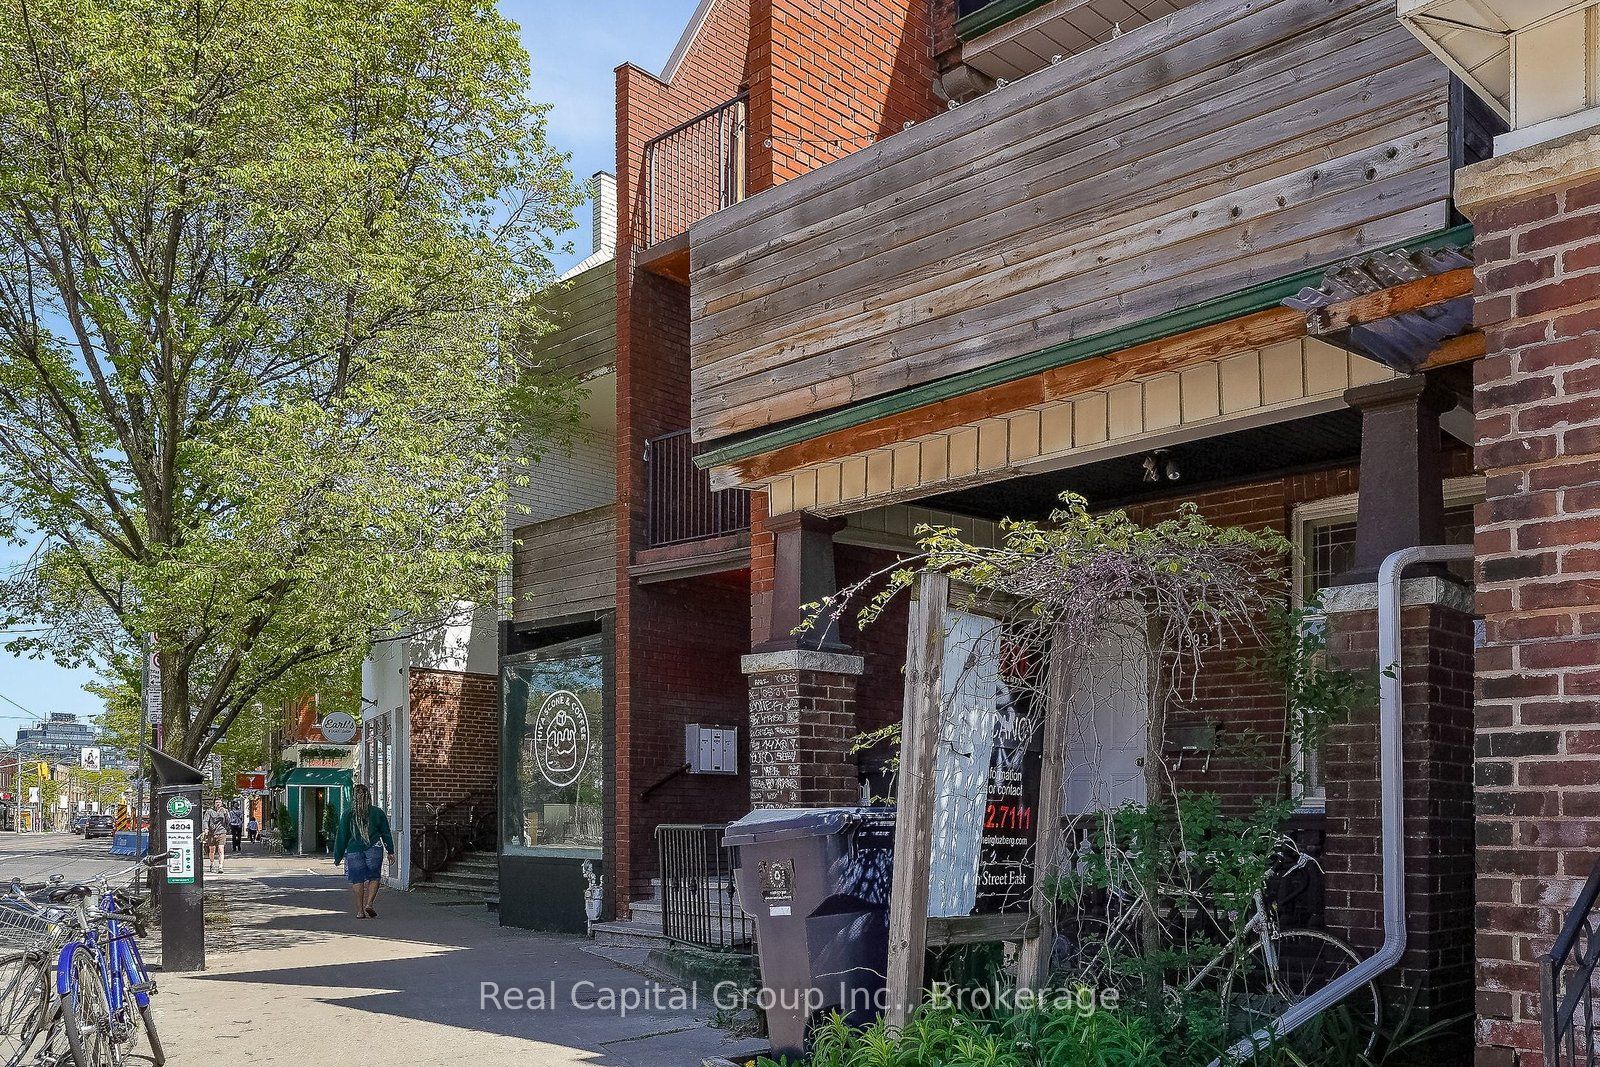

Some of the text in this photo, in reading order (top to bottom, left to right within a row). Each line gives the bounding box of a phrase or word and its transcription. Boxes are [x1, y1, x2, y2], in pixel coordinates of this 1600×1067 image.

[1185, 633, 1208, 648] 393
[324, 718, 355, 730] Earl's
[537, 696, 587, 741] HIYA SCONE & COFFEE
[992, 714, 1032, 743] CANCY
[989, 766, 1022, 782] formation
[997, 783, 1023, 796] contact
[981, 870, 1008, 886] Street
[1008, 870, 1027, 885] East
